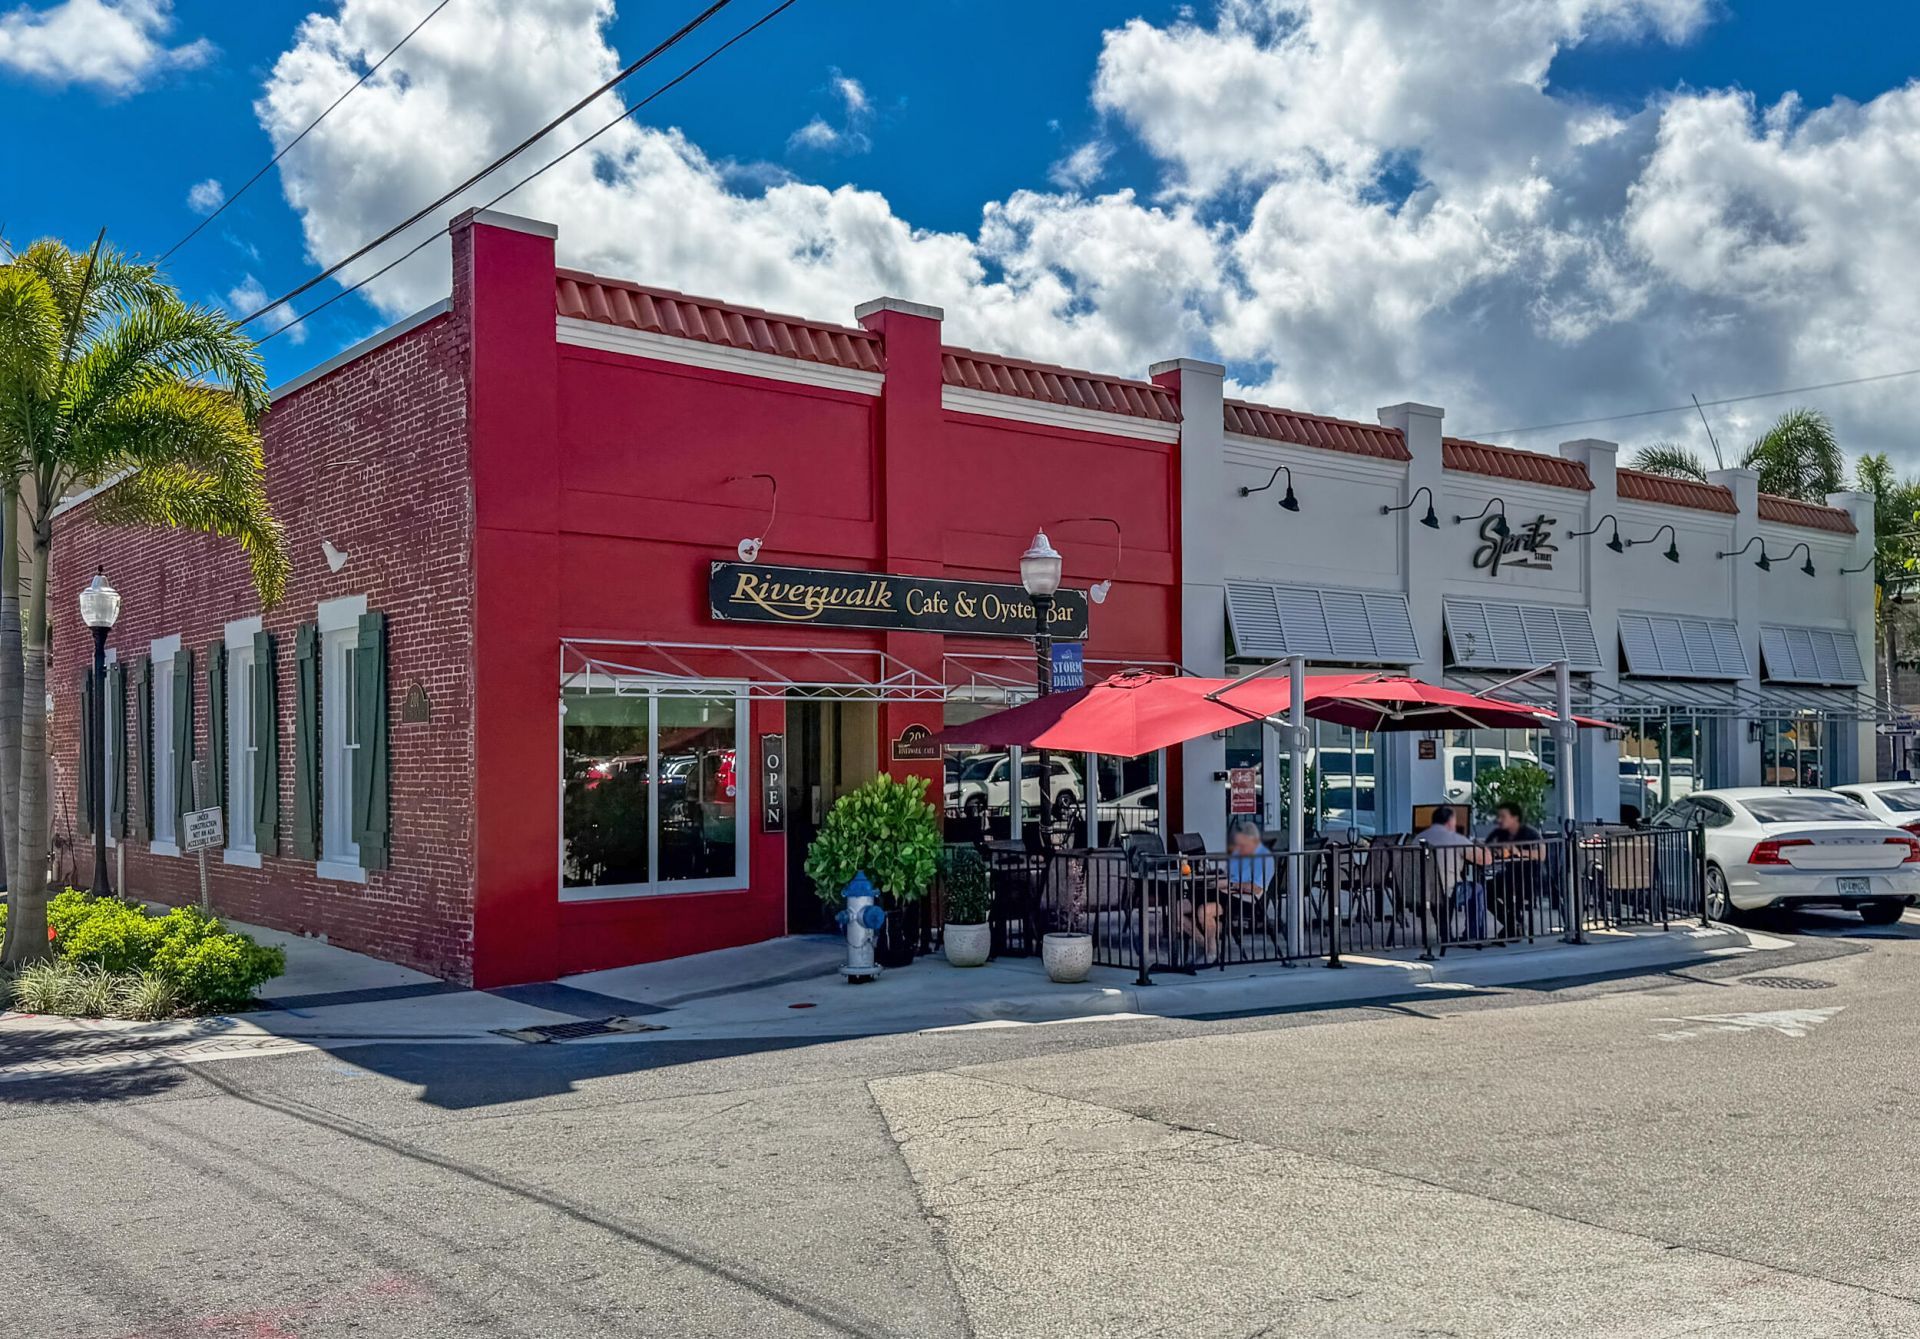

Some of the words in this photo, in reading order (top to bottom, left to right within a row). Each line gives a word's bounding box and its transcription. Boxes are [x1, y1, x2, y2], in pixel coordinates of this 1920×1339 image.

[730, 572, 893, 619] Riverwalk
[906, 588, 949, 616] Cafe
[954, 590, 977, 618] &
[1046, 599, 1074, 623] Bar
[1053, 661, 1083, 673] STORM
[1053, 675, 1084, 687] DRAINS
[766, 754, 780, 823] OPEN
[190, 820, 217, 831] CONSTRUCTION
